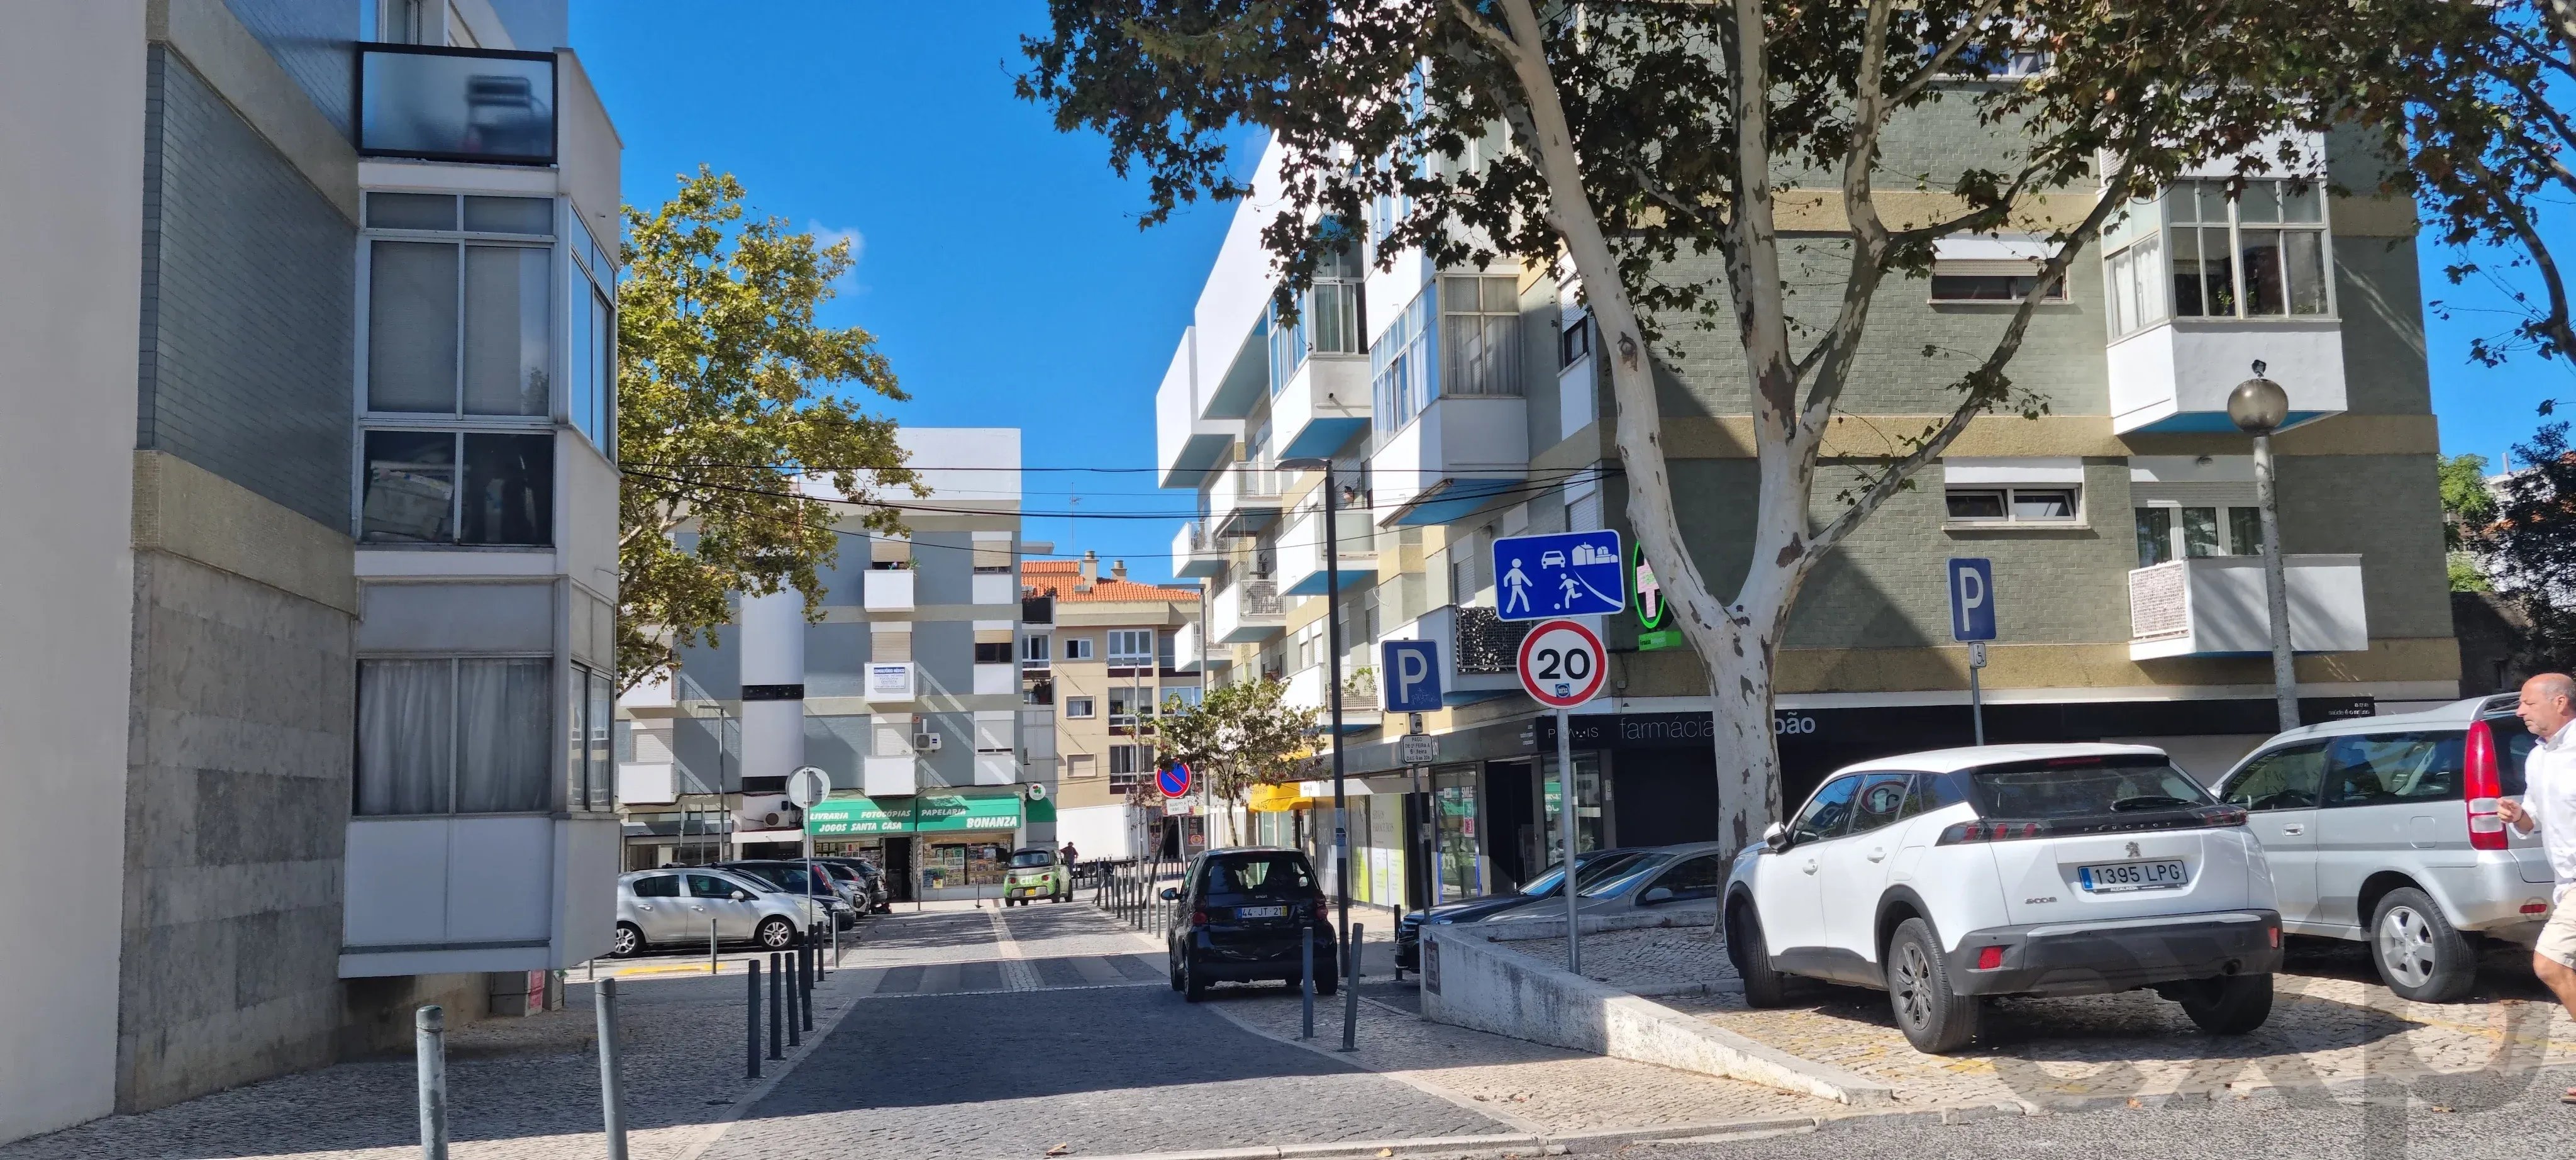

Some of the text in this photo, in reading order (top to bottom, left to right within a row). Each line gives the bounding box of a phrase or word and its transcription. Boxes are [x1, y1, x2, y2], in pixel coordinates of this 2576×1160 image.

[1959, 567, 1984, 632] P
[1538, 649, 1591, 680] 20
[1397, 649, 1428, 704] P
[809, 810, 911, 820] LIVRARIA FOTOCÓPIAS
[921, 808, 967, 817] PAPELARIA
[819, 822, 902, 832] JOGOS SANTA CASA
[966, 816, 1017, 828] BONANZA
[2084, 822, 2172, 832] PEUGEOT
[2096, 864, 2180, 885] 1395 LPG
